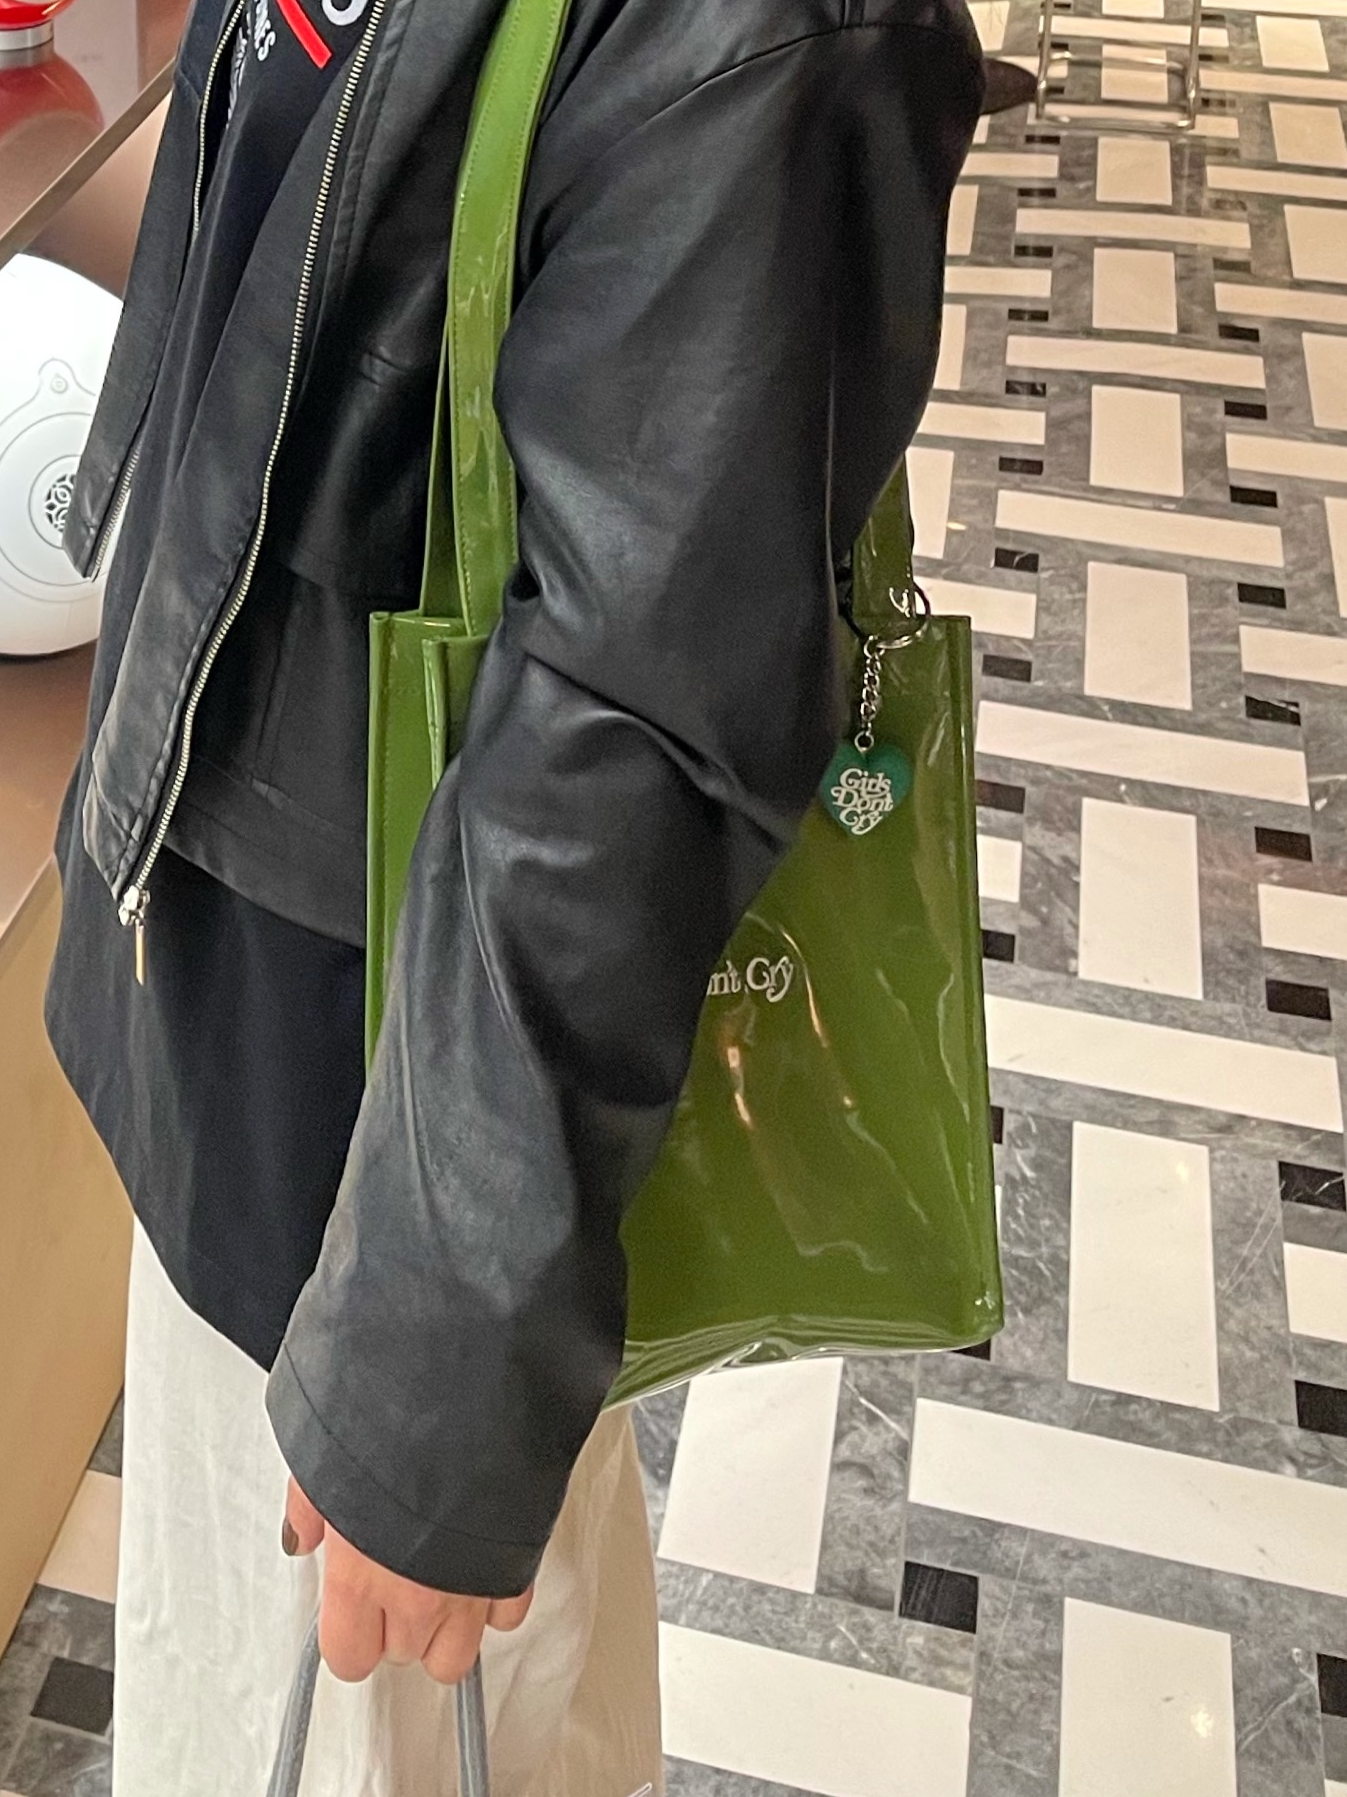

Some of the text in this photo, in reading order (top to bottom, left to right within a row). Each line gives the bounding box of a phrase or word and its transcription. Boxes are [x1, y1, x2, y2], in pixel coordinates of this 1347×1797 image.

[840, 768, 892, 798] Girls
[839, 807, 884, 835] Cry
[746, 956, 794, 1003] Cry
